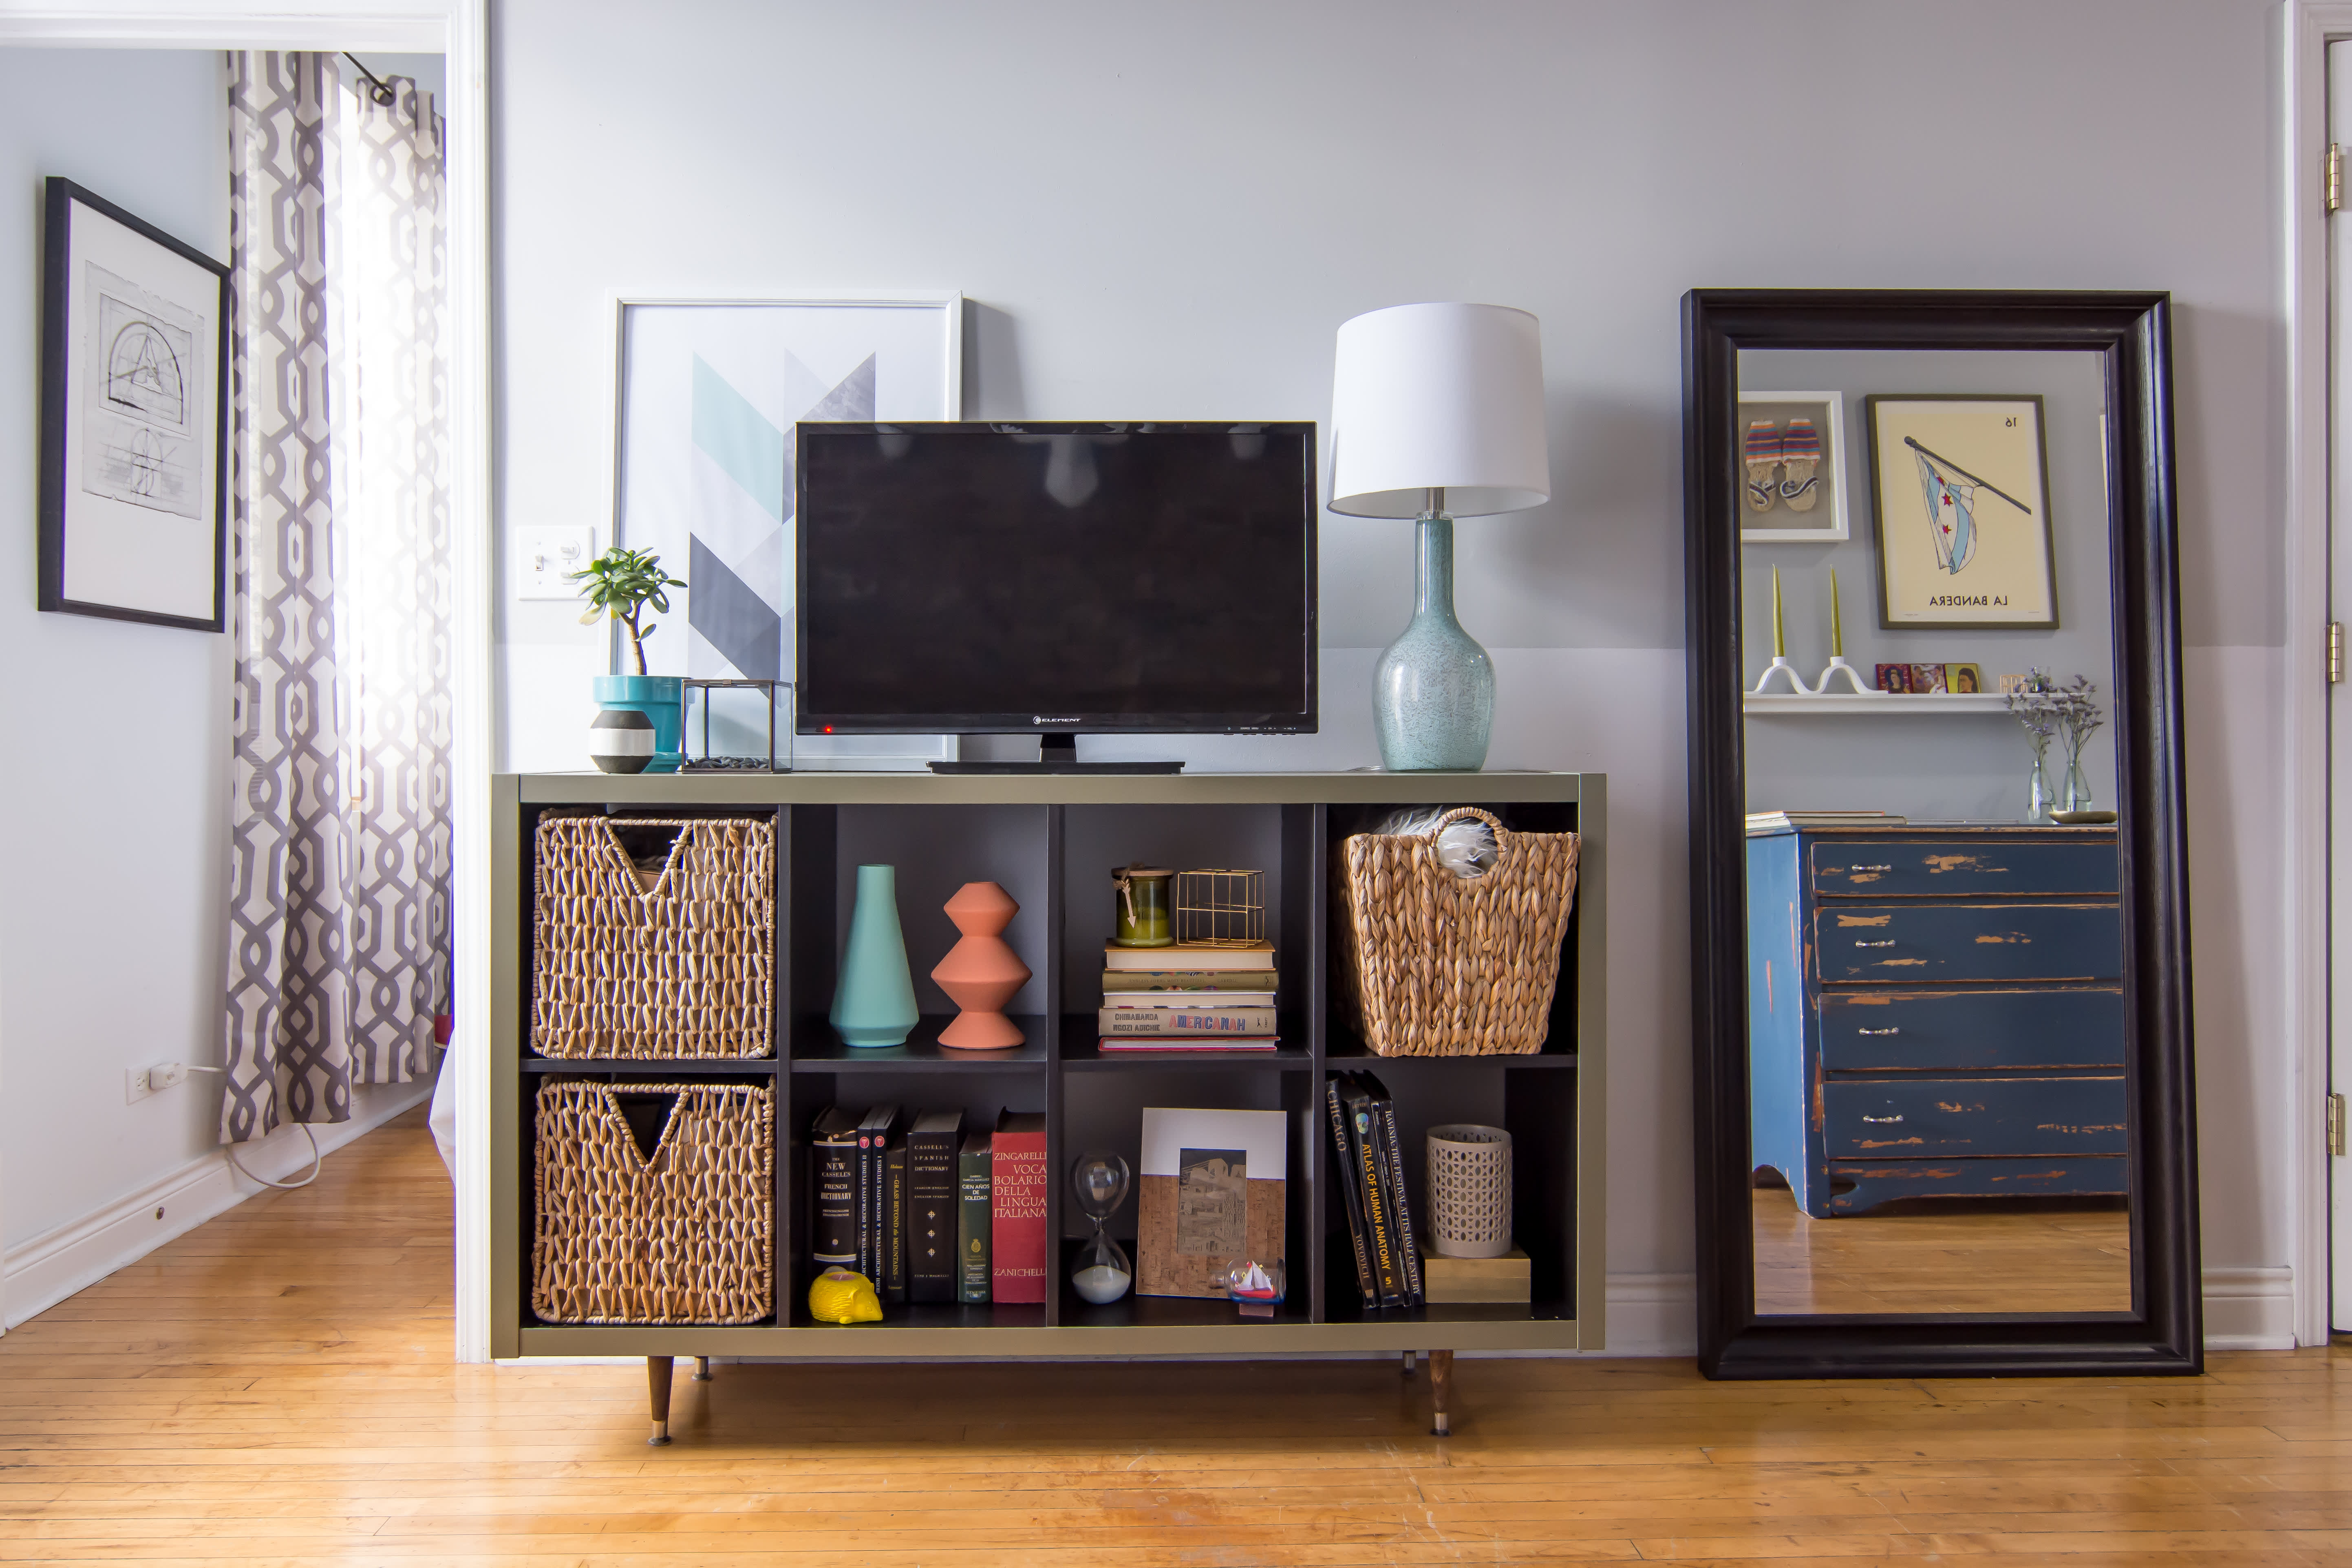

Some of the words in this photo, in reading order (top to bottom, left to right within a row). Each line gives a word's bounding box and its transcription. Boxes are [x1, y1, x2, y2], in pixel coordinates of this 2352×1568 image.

[1169, 1015, 1245, 1031] AMERICANAH
[1328, 1090, 1347, 1151] CHICAGO
[994, 1152, 1047, 1160] ZINGARELLI
[1362, 1144, 1374, 1172] ATLAS
[1391, 1147, 1399, 1165] THE
[1013, 1164, 1046, 1174] VOCA
[994, 1175, 1047, 1185] BOLARIO
[1367, 1173, 1377, 1186] OF
[1394, 1167, 1406, 1205] FESTIVAL
[995, 1186, 1031, 1196] DELLA
[1001, 1197, 1046, 1207] LINGUA
[1369, 1188, 1383, 1223] HUMAN
[994, 1208, 1046, 1218] ITALIANA
[1400, 1206, 1408, 1215] AT
[1375, 1226, 1391, 1270] ANATOMY
[1405, 1233, 1414, 1254] HALF
[1356, 1233, 1370, 1278] YOVOVICH
[994, 1268, 1045, 1277] ZANICHELL
[1408, 1256, 1420, 1295] CENTURY
